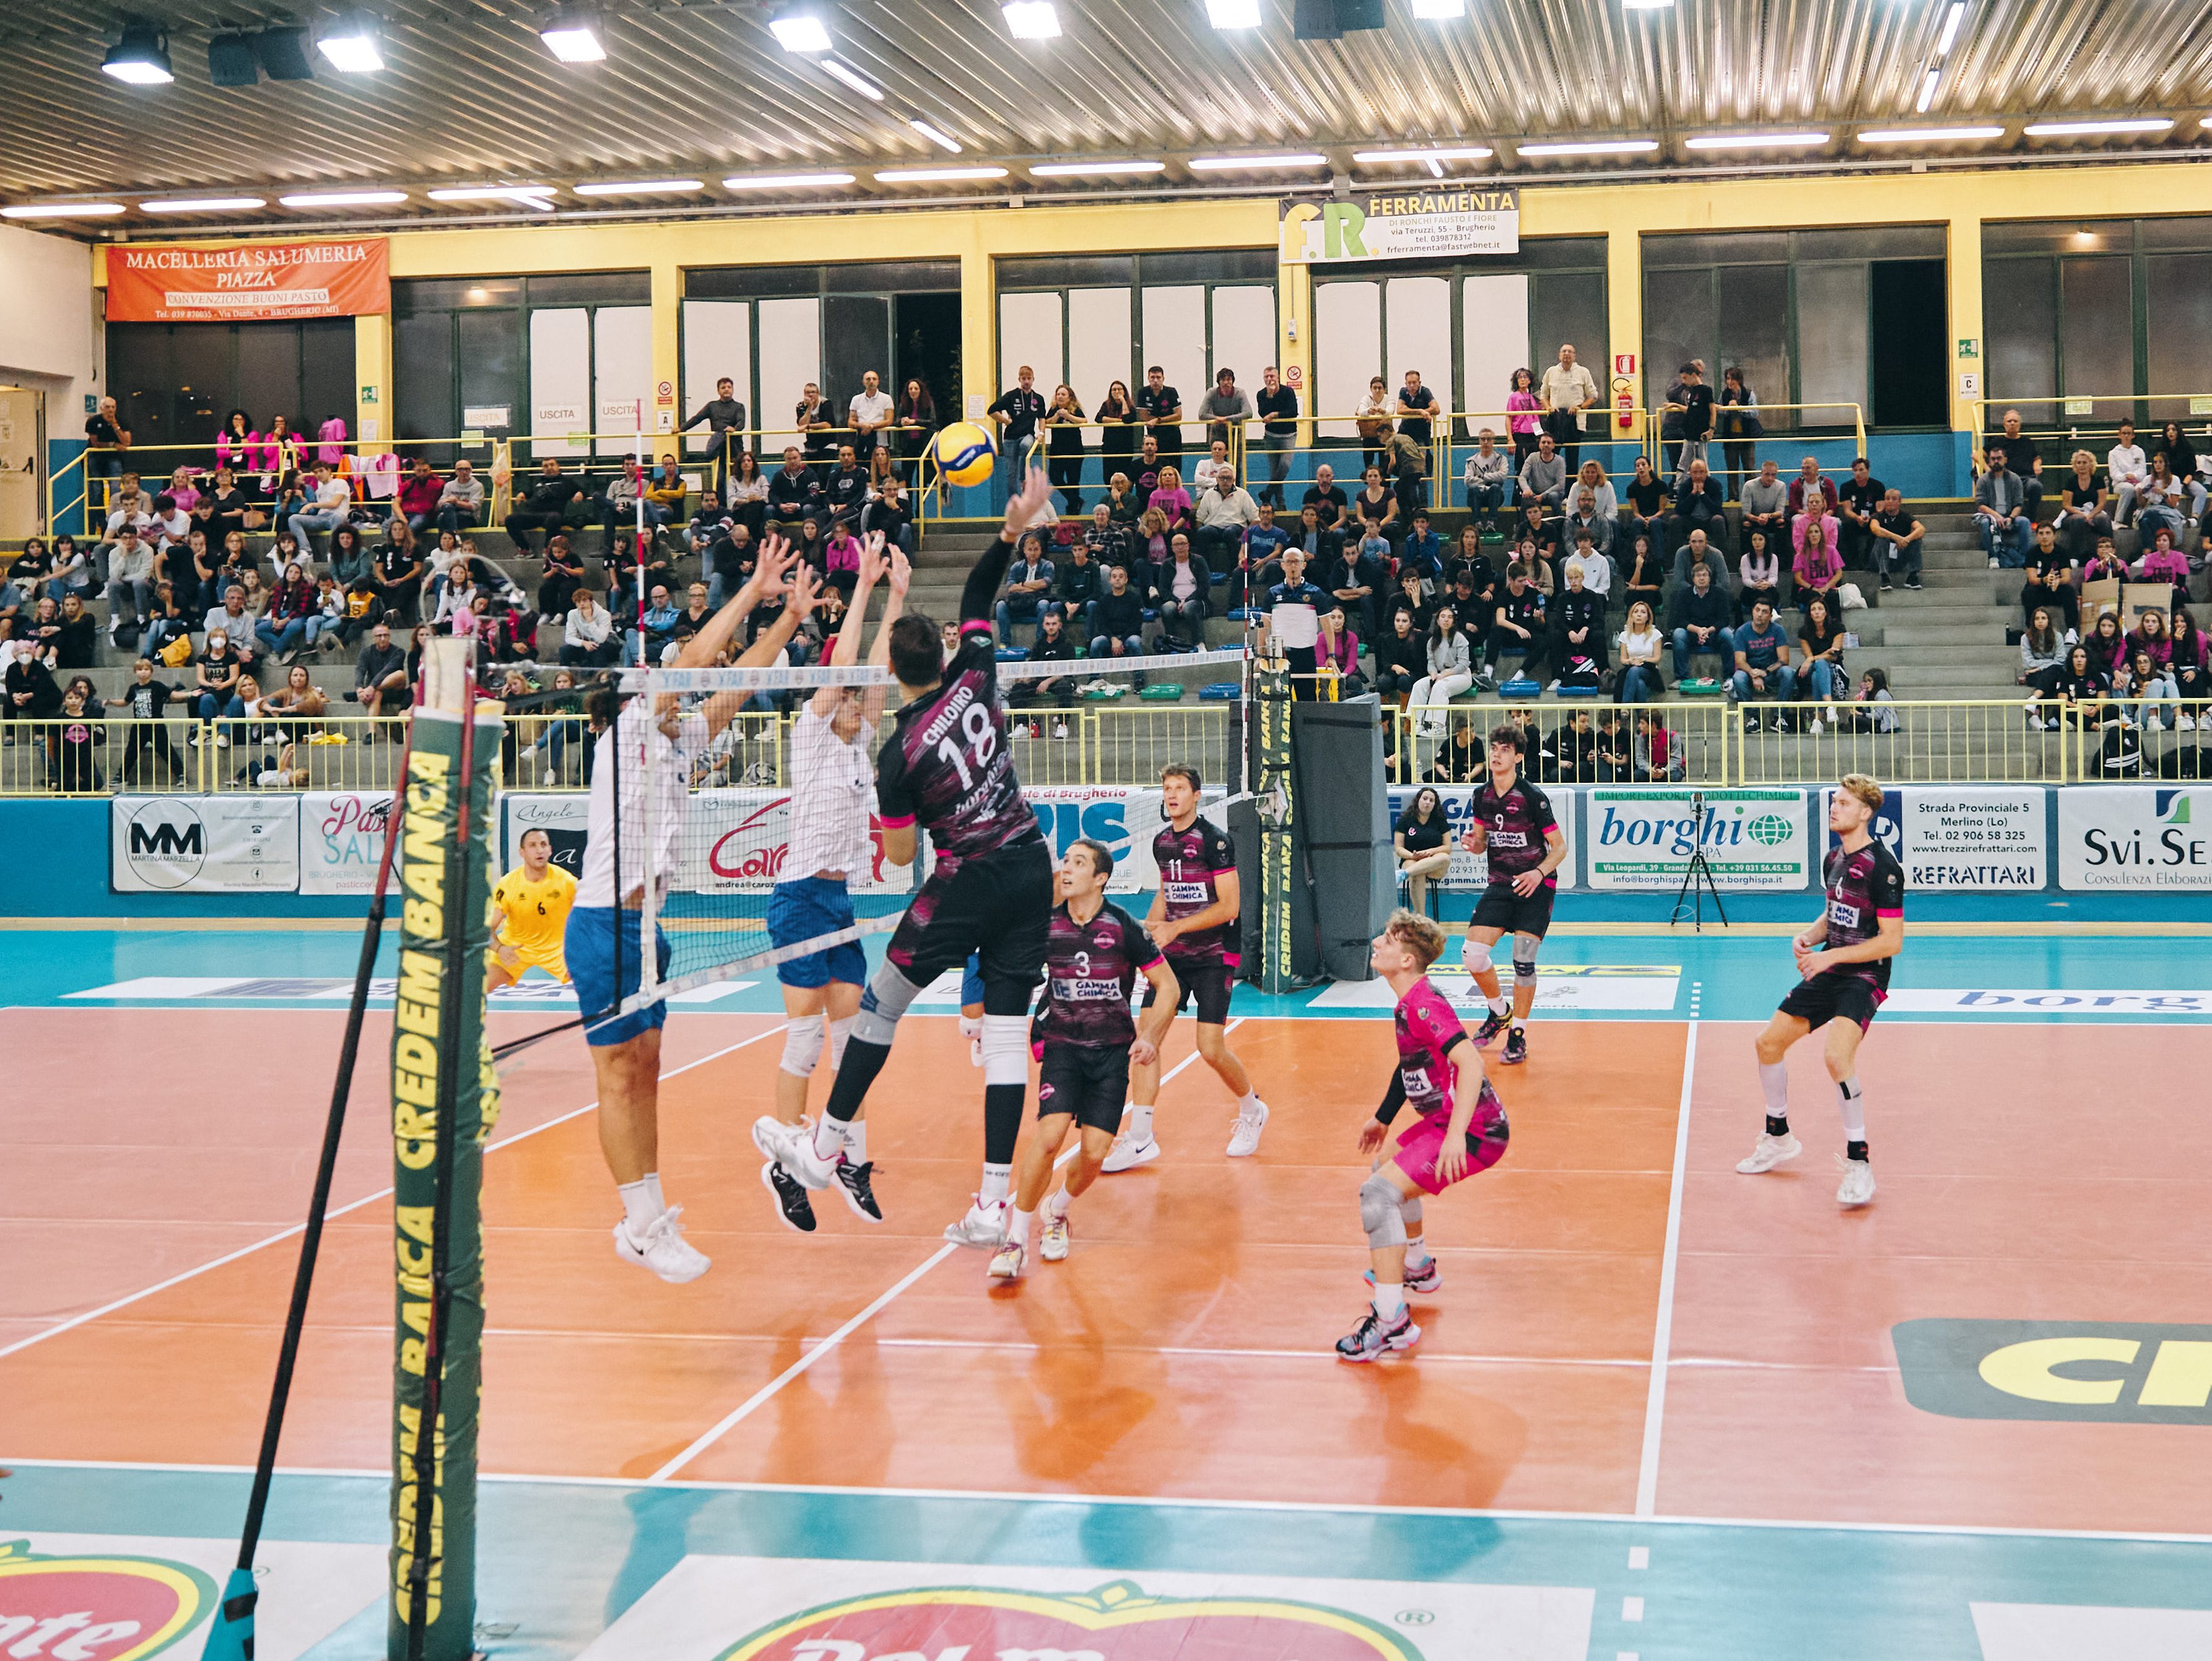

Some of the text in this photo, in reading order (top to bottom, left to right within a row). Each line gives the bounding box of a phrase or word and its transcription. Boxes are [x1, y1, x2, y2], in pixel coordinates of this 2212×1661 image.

[1370, 193, 1515, 217] FERRAMENTA
[1400, 217, 1432, 226] RONCHI
[1434, 216, 1466, 224] FAUSTO
[1474, 214, 1497, 222] FIORE
[1405, 227, 1434, 235] Teruzzi,
[1457, 224, 1496, 233] Brugherio
[1430, 233, 1471, 242] 039878312
[1387, 242, 1500, 254] frferramenta@fastwebnet.it
[126, 245, 367, 269] MACELLERIA SALUMERIA
[217, 271, 276, 288] PIAZZA
[167, 292, 327, 304] CONVENZIONE BUONI PASTO
[155, 310, 169, 318] Tel.
[219, 310, 231, 318] Via
[271, 306, 321, 316] BRUGHERIO
[322, 305, 339, 315] (MI)
[1966, 380, 1972, 388] C
[540, 410, 575, 419] USCITA
[603, 406, 637, 415] USCITA
[466, 414, 501, 422] USCITA
[922, 686, 973, 746] CHILOIRO
[938, 702, 996, 791] 18
[1044, 789, 1056, 798] di
[1060, 788, 1127, 800] Brugherio
[515, 803, 576, 824] Angelo
[1919, 803, 2029, 813] Strada Provinciale 5
[1495, 813, 1504, 830] 9
[1941, 817, 2008, 827] Merlino (Lo)
[1600, 806, 1744, 856] borghi
[1924, 831, 2025, 840] Tel. 02 906 58 325
[131, 822, 202, 854] MM
[1912, 844, 2037, 853] www.trezzirefrattari.com
[1169, 859, 1182, 881] 11
[1616, 864, 1646, 873] Leopardi,
[1912, 866, 2035, 884] REFRATTARI
[1835, 877, 1842, 900] 6
[538, 902, 546, 915] 6
[1281, 902, 1291, 977] CREDEM
[1074, 951, 1091, 977] 3
[1076, 981, 1117, 990] GAMMA
[393, 952, 442, 1169] CREDEM
